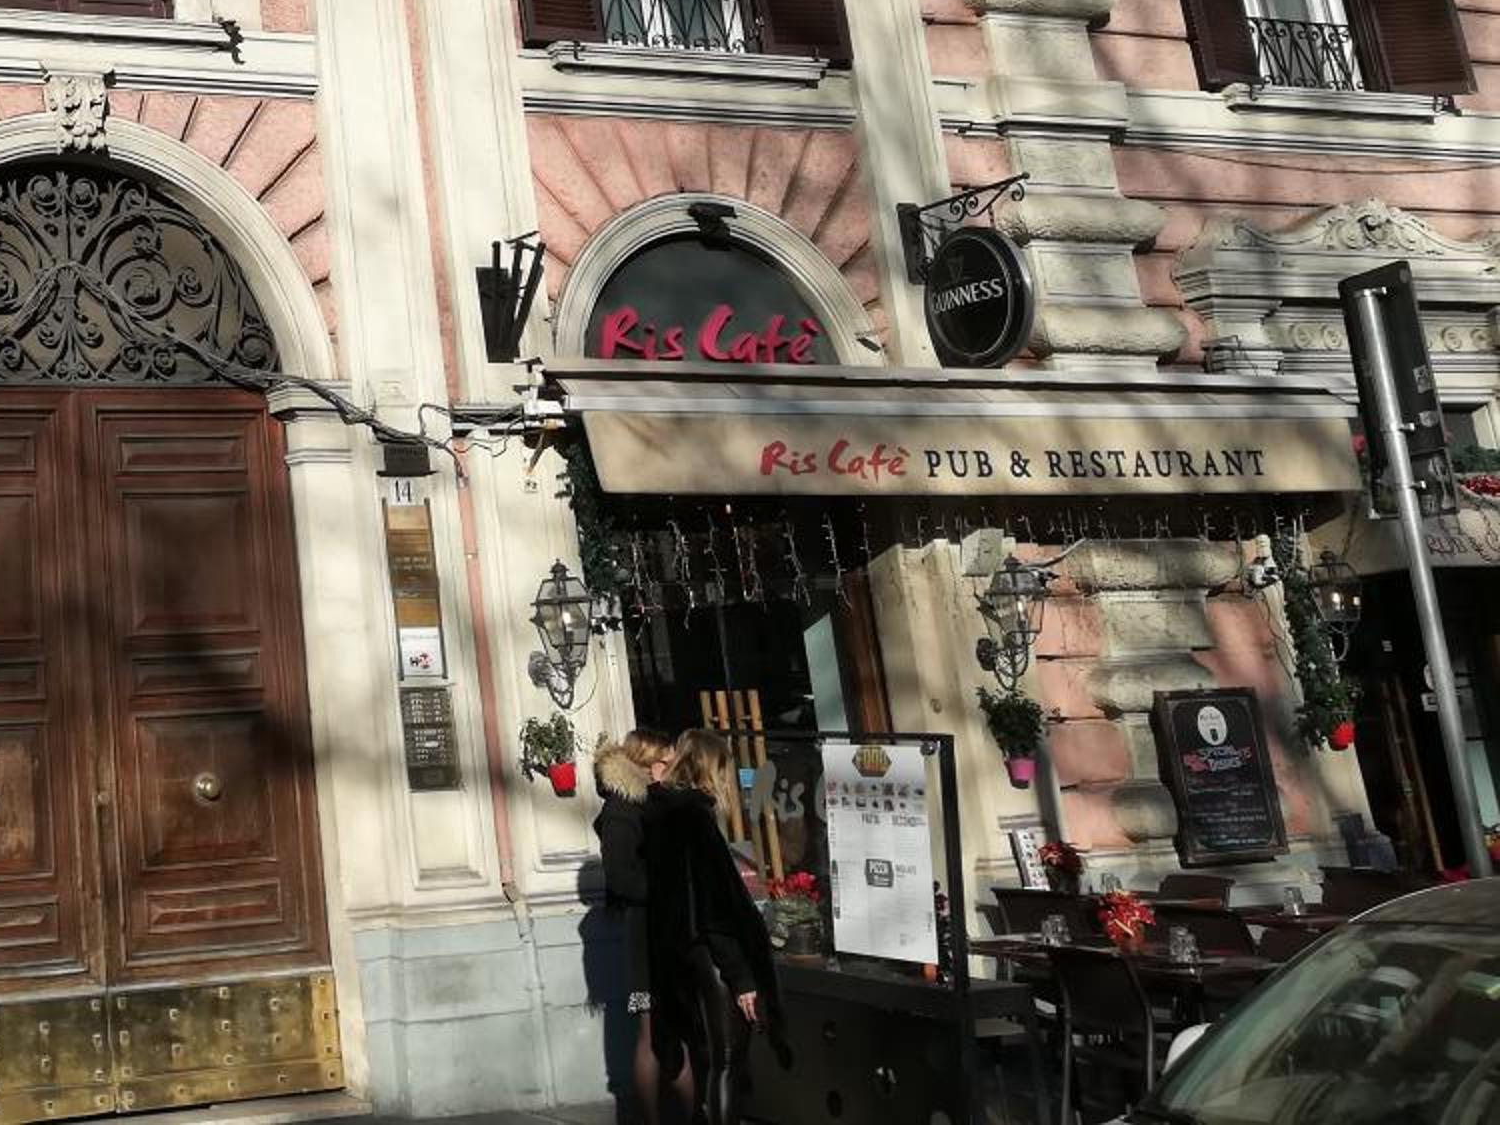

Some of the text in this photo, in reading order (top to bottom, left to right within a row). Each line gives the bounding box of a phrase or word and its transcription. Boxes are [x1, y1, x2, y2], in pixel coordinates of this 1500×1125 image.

[932, 278, 1004, 314] GUINNESS
[599, 304, 685, 361] Ris
[759, 440, 818, 477] Ris
[923, 449, 995, 479] PUB
[1008, 450, 1033, 479] &
[1048, 449, 1265, 479] RESTAURANT
